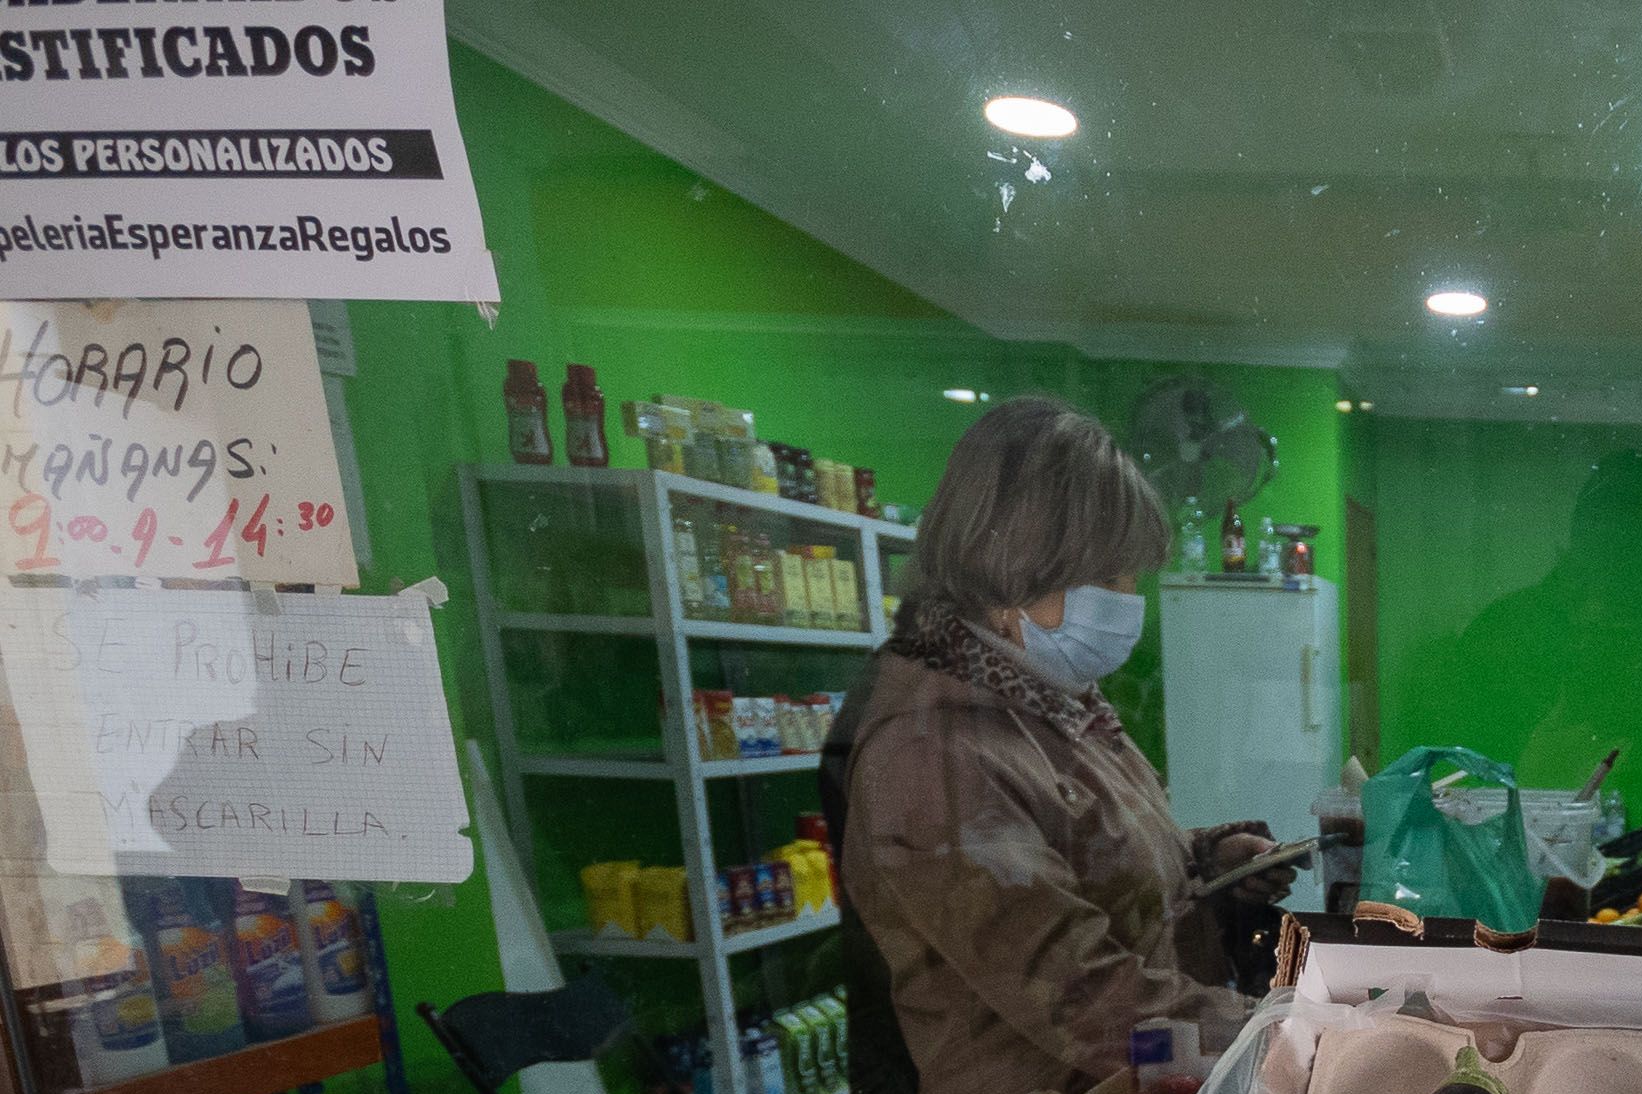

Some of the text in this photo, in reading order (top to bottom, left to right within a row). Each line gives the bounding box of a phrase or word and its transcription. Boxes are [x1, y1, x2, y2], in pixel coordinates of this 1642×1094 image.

[0, 25, 376, 81] STIFICADOS
[72, 136, 394, 172] PERSONALIZADOS
[94, 711, 261, 761] ENTRAR
